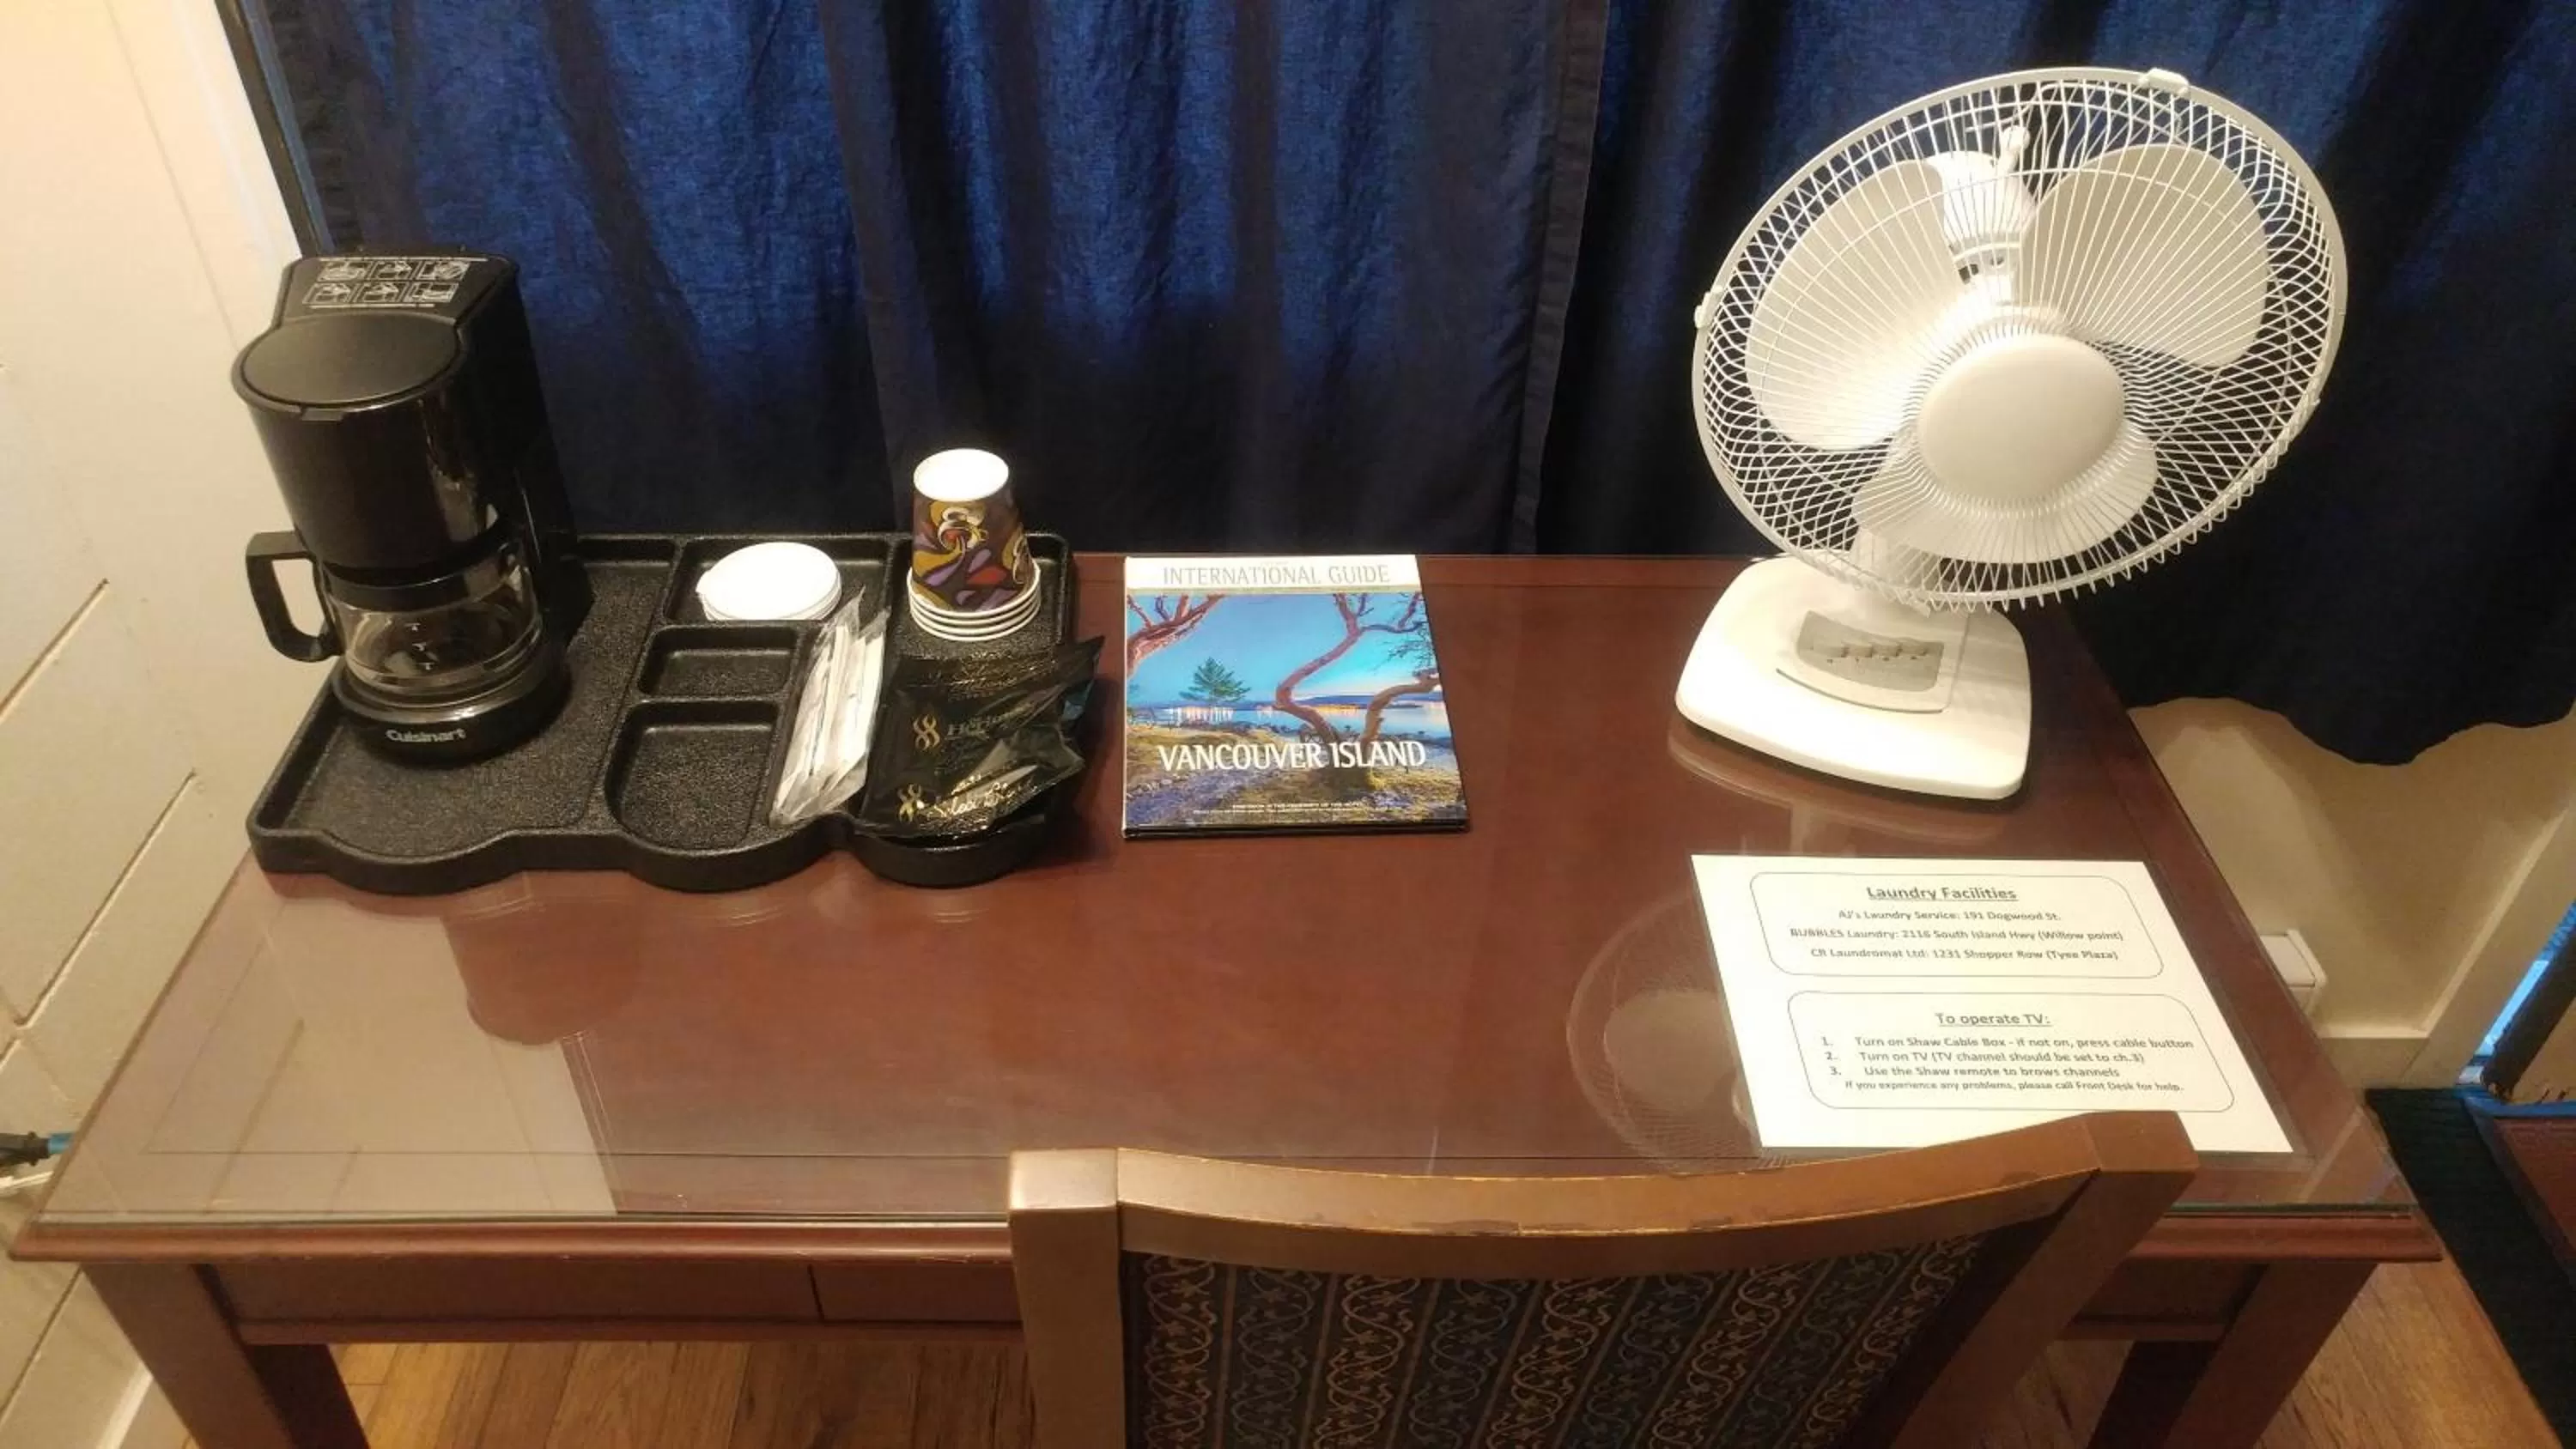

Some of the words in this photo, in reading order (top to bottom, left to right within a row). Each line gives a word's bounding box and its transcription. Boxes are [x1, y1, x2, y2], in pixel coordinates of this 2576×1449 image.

[1163, 566, 1321, 585] INTERNATIONAL
[1328, 565, 1391, 584] GUIDE
[385, 729, 467, 743] Cuisinart
[1158, 742, 1324, 771] VANCOUVER
[1331, 741, 1426, 768] ISLAND
[1867, 887, 1937, 900] Laundry
[1941, 888, 2018, 901] Facilities
[1864, 911, 1911, 921] Laundry
[1987, 912, 2043, 922] Dogwood
[1790, 929, 1844, 938] BUBBLES
[1847, 930, 1900, 940] Laundry:
[1933, 930, 1969, 939] South
[1971, 931, 2007, 940] Island
[2008, 931, 2036, 941] Hwy
[2038, 931, 2085, 942] (Willow
[2087, 931, 2124, 942] point)
[1811, 949, 1827, 958] CR
[1830, 949, 1904, 959] Laundromat
[1932, 949, 1962, 959] 1231
[1964, 949, 2014, 960] Shopper
[2016, 950, 2044, 959] Row
[2045, 949, 2080, 960] (Tyee
[2081, 950, 2119, 961] Plaza)
[1935, 1013, 1956, 1025] To
[1959, 1015, 2020, 1027] operate
[2023, 1014, 2051, 1025] TV:
[1821, 1036, 1834, 1046] 1.
[1855, 1036, 1885, 1046] Turn
[1906, 1037, 1941, 1046] Shaw
[1943, 1037, 1979, 1046] Cable
[1981, 1037, 2007, 1046] Box
[2016, 1037, 2026, 1046] if
[2028, 1038, 2050, 1047] not
[2053, 1040, 2075, 1049] on,
[2075, 1039, 2111, 1049] press
[2113, 1038, 2148, 1048] cable
[2149, 1037, 2195, 1048] button
[1825, 1052, 1838, 1061] 2.
[1859, 1052, 1890, 1061] Turn
[1912, 1052, 1929, 1061] TV
[1932, 1052, 1953, 1063] (TV
[1957, 1052, 2006, 1062] channel
[2008, 1052, 2052, 1062] should
[2054, 1052, 2072, 1062] be
[2074, 1053, 2094, 1062] set
[2096, 1053, 2110, 1062] to
[1830, 1066, 1843, 1076] 3.
[1864, 1066, 1889, 1076] Use
[1892, 1066, 1913, 1076] the
[1915, 1066, 1951, 1076] Shaw
[1953, 1068, 2001, 1076] remote
[2002, 1067, 2017, 1076] to
[2020, 1066, 2060, 1076] brows
[2063, 1066, 2121, 1076] channels
[1845, 1081, 1853, 1089] If
[1856, 1082, 1877, 1091] you
[1879, 1081, 1938, 1091] experience
[1940, 1082, 1959, 1091] any
[1962, 1081, 2017, 1091] problems,
[2019, 1081, 2053, 1091] please
[2055, 1081, 2073, 1090] call
[2075, 1080, 2105, 1090] Front
[2107, 1081, 2134, 1090] Desk
[2136, 1081, 2154, 1091] for
[2155, 1082, 2185, 1093] help.
